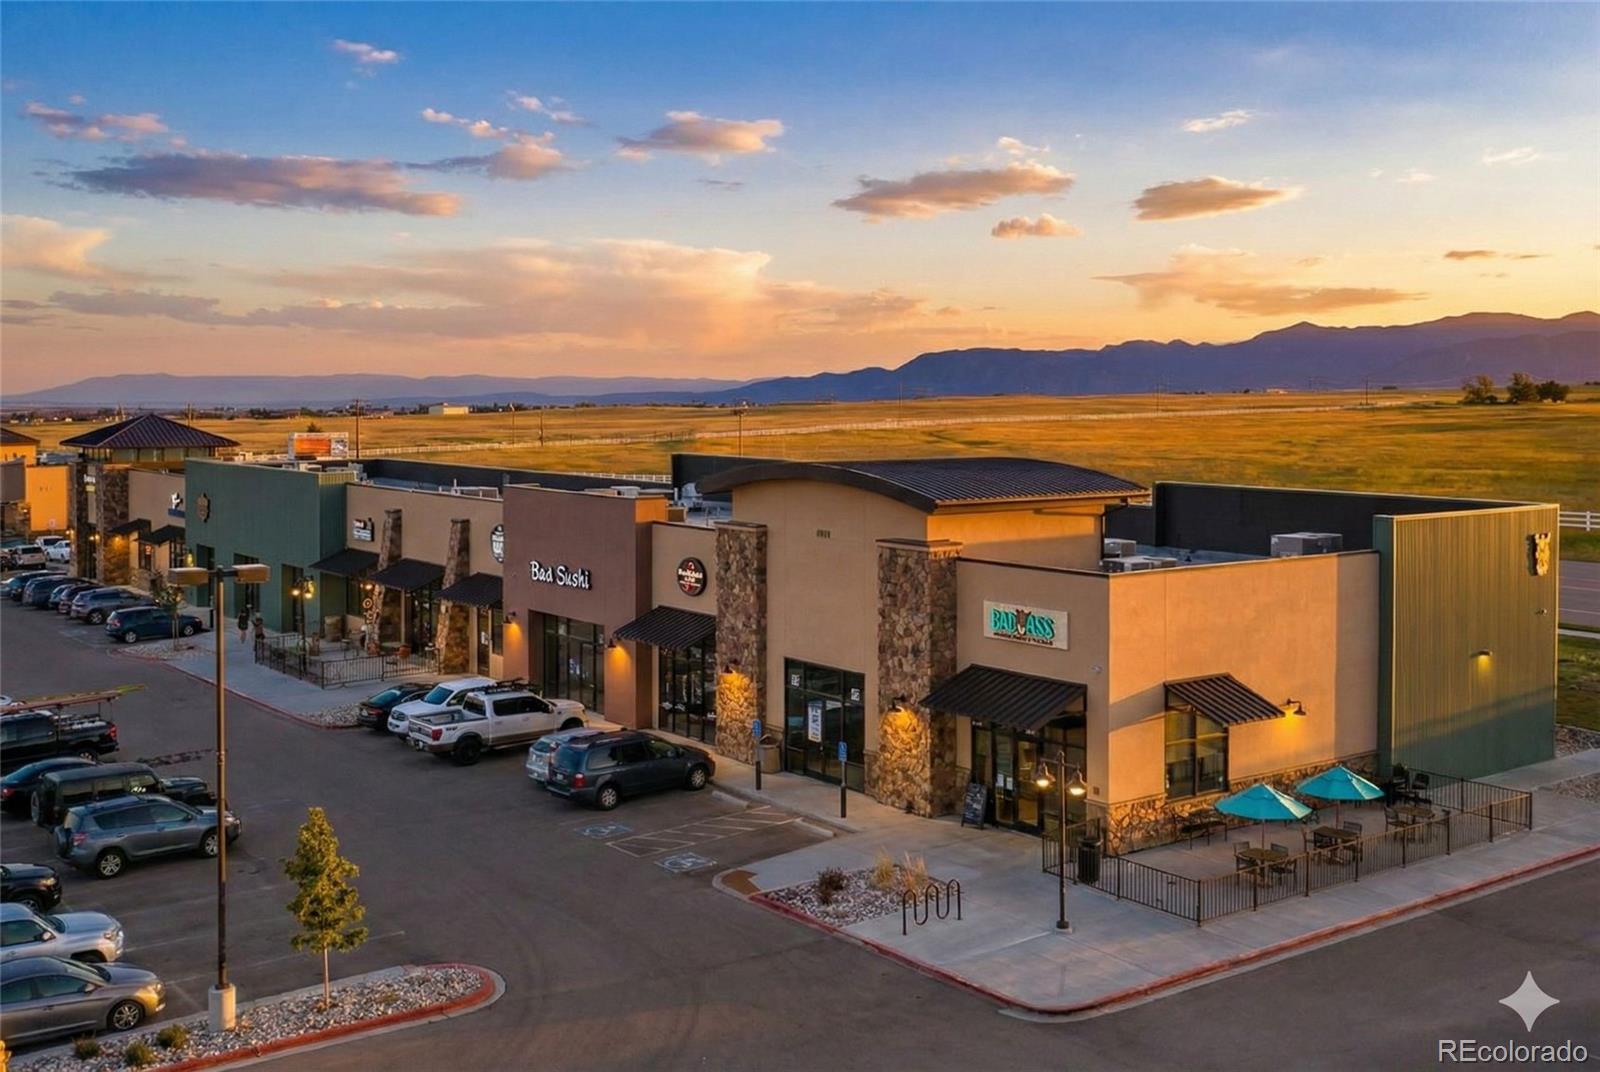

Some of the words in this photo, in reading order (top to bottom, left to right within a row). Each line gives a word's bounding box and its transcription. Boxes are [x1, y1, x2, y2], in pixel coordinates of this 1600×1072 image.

[529, 560, 554, 582] Bad
[556, 565, 590, 589] Sushi
[991, 608, 1017, 633] BAD
[1026, 614, 1055, 640] ASS
